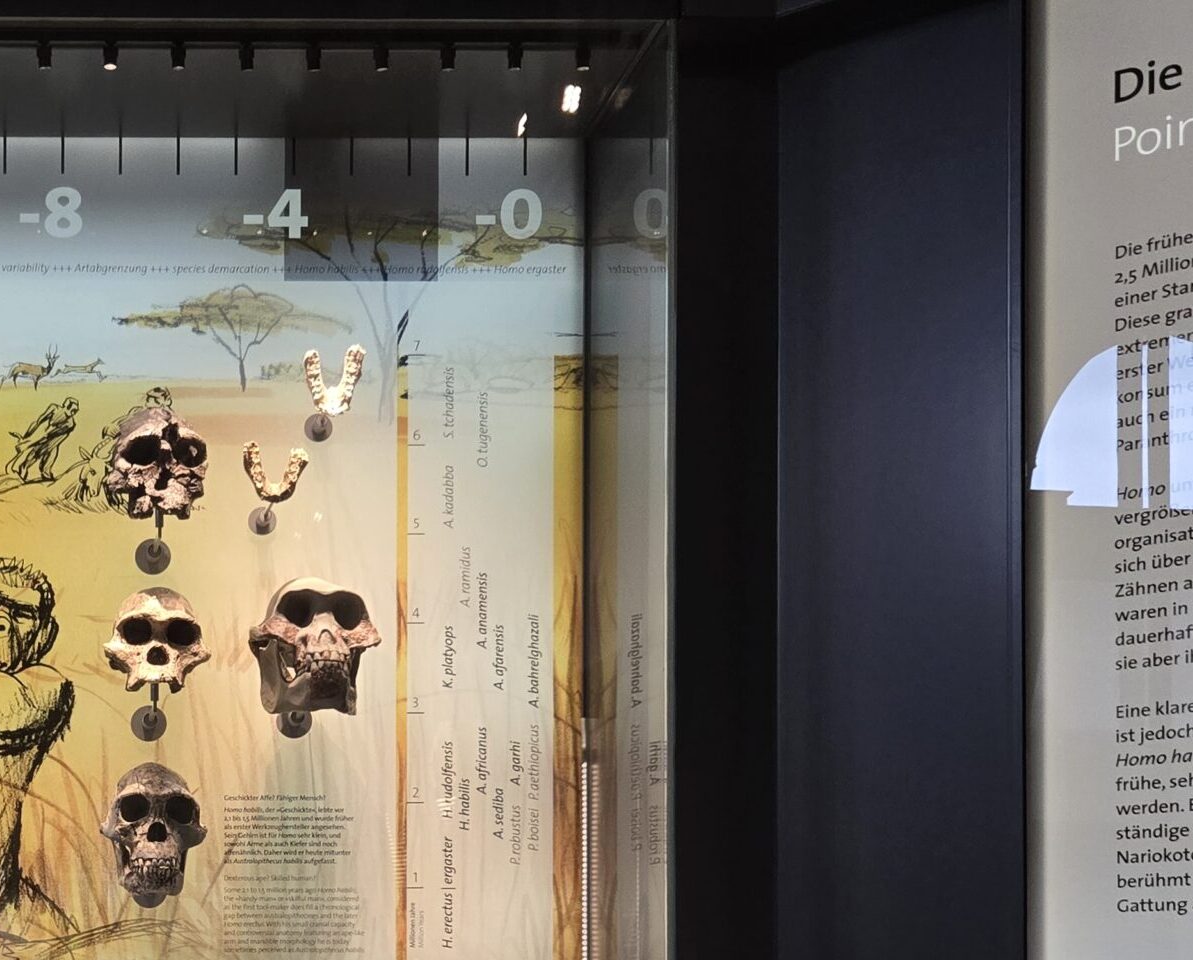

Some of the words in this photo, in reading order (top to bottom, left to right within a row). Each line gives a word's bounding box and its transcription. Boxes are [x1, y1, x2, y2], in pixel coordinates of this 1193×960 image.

[1114, 60, 1183, 103] Die
[19, 186, 83, 238] -8
[243, 188, 309, 239] -4
[476, 188, 543, 240] -0
[1115, 243, 1143, 260] Die
[1, 262, 50, 275] variability
[73, 263, 148, 276] Artabgrenzung
[172, 263, 206, 276] species
[207, 263, 270, 274] demarcation
[294, 263, 325, 274] Homo
[326, 264, 359, 274] habilis
[384, 263, 414, 274] Homo
[493, 263, 524, 274] Homo
[526, 263, 566, 276] ergaster
[1115, 269, 1137, 284] 2,5
[1115, 289, 1158, 307] einer
[413, 340, 421, 350] 7
[442, 367, 454, 428] tchadensis
[477, 391, 491, 454] tugenensis
[412, 429, 421, 440] 6
[443, 430, 454, 439] S.
[477, 456, 488, 468] O.
[442, 465, 454, 516] kadabba
[413, 518, 420, 529] 5
[443, 517, 454, 529] A.
[459, 546, 471, 594] ramidus
[1115, 556, 1146, 574] sich
[1151, 553, 1191, 569] über
[1115, 581, 1178, 598] Zähnen
[460, 596, 471, 608] A.
[477, 572, 488, 635] anamensis
[412, 608, 420, 618] 4
[1115, 606, 1167, 622] waren
[1172, 602, 1188, 615] in
[442, 625, 456, 676] platyops
[477, 636, 488, 649] A.
[527, 614, 542, 694] bahrelghazali
[1115, 656, 1138, 670] sie
[1142, 652, 1180, 668] aber
[442, 678, 453, 689] K.
[412, 697, 420, 707] 3
[528, 696, 539, 709] A.
[1116, 704, 1151, 719] Eine
[475, 727, 489, 781] africanus
[1115, 753, 1167, 767] Homo
[476, 783, 487, 795] A.
[1115, 775, 1166, 791] frühe,
[412, 787, 420, 798] 2
[458, 778, 470, 817] habilis
[1116, 799, 1185, 815] werden.
[459, 818, 470, 831] H.
[1116, 823, 1190, 842] ständige
[1117, 872, 1191, 889] berühmt
[1117, 898, 1188, 916] Gattung
